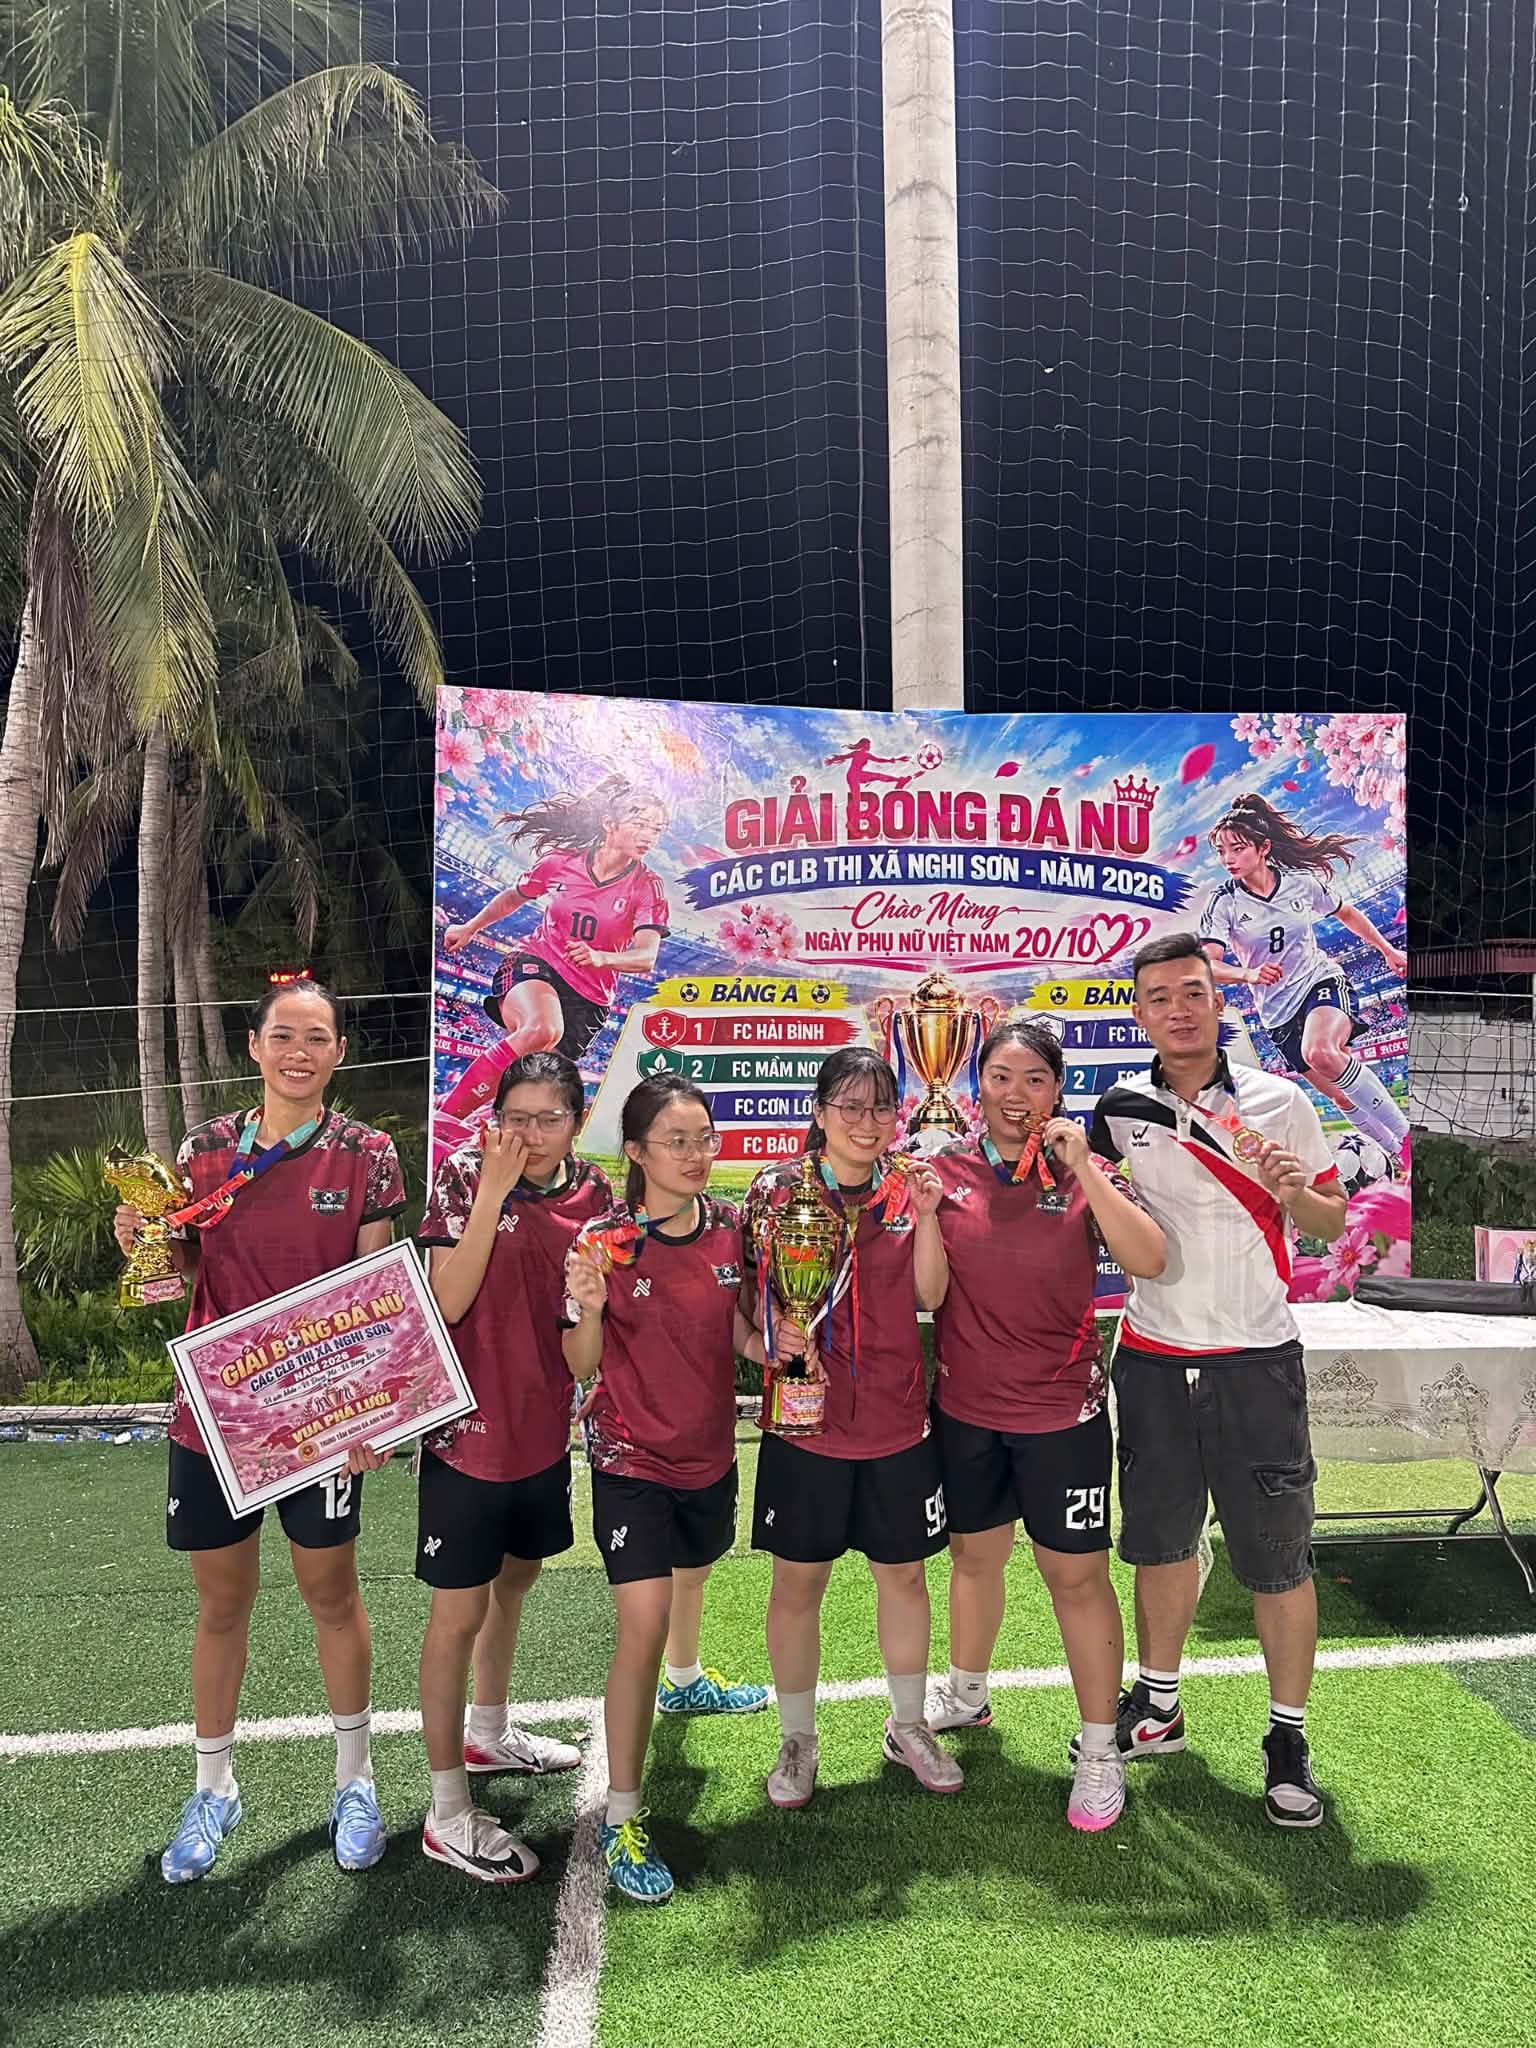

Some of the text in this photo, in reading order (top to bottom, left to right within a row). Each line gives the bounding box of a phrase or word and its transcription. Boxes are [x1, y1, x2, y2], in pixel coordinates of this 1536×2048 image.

[725, 775, 833, 849] GIẢI
[996, 787, 1070, 848] ĐÁ
[710, 861, 763, 898] CÁC
[770, 857, 818, 887] CLB
[823, 853, 862, 885] THỊ
[868, 849, 901, 880] XÃ
[908, 853, 965, 880] NGHI
[970, 853, 1020, 882] SƠN
[1040, 856, 1095, 890] NĂM
[1102, 867, 1164, 901] 2026
[852, 891, 1001, 931] Chào Mừng
[570, 911, 598, 941] 10
[1269, 926, 1285, 954] 8
[805, 926, 1097, 959] NGÀY PHỤ NỮ VIỆT NAM 20/10
[711, 978, 799, 1003] BẢNG A
[1084, 980, 1137, 1005] BẢN
[693, 1019, 824, 1041] 1 FC HẢI BÌNH
[1074, 1025, 1083, 1043] 1
[1108, 1026, 1126, 1042] FC
[691, 1055, 824, 1078] 2 FC MẦM NO
[1073, 1070, 1085, 1090] 2
[735, 1094, 816, 1115] FC CƠN LỐ
[743, 1133, 798, 1154] FC BÃO
[1096, 1262, 1125, 1275] MED
[222, 1346, 268, 1387] GIẢI
[334, 1301, 369, 1331] ĐÁ
[371, 1289, 405, 1318] NỮ
[251, 1371, 274, 1392] CÁC
[275, 1360, 295, 1379] CLB
[296, 1351, 315, 1366] THỊ
[334, 1331, 364, 1350] NGHI
[366, 1322, 392, 1339] SƠN
[294, 1352, 349, 1382] NĂM 2026
[292, 1390, 392, 1443] VUA PHÁ LƯỚI
[453, 1417, 487, 1435] MPIRE
[319, 1473, 352, 1519] 12
[1066, 1486, 1105, 1530] 29
